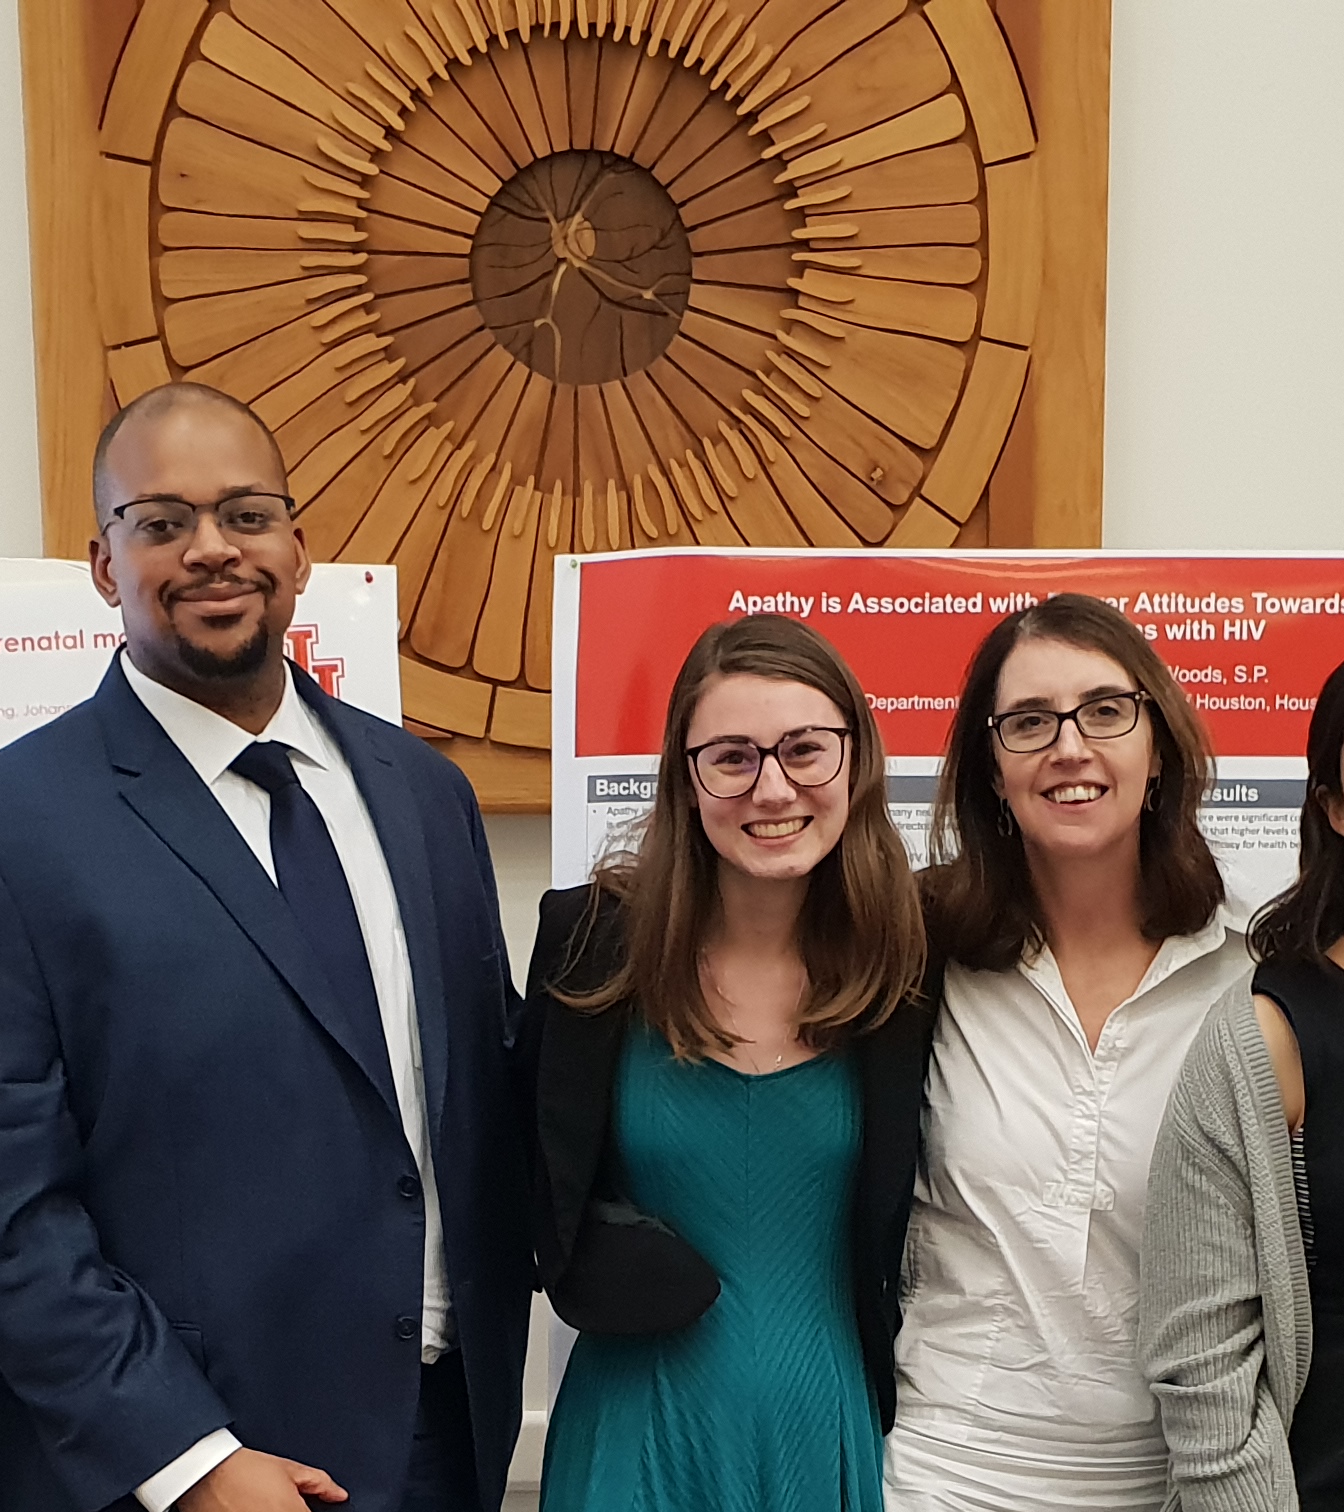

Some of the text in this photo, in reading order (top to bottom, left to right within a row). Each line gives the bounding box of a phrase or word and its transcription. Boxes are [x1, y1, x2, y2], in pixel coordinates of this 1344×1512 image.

[729, 590, 814, 618] Apathy
[821, 592, 841, 613] is
[847, 592, 983, 614] Associated
[1134, 592, 1244, 614] Attitudes
[1166, 619, 1215, 640] with
[1223, 619, 1266, 641] HIV
[1234, 665, 1268, 683] S.P.
[865, 694, 959, 712] Department
[1196, 694, 1270, 712] Houston,
[1216, 814, 1239, 822] were
[1242, 812, 1288, 824] significant
[1231, 826, 1260, 837] higher
[1262, 826, 1288, 836] levels
[1242, 839, 1287, 849] for health
